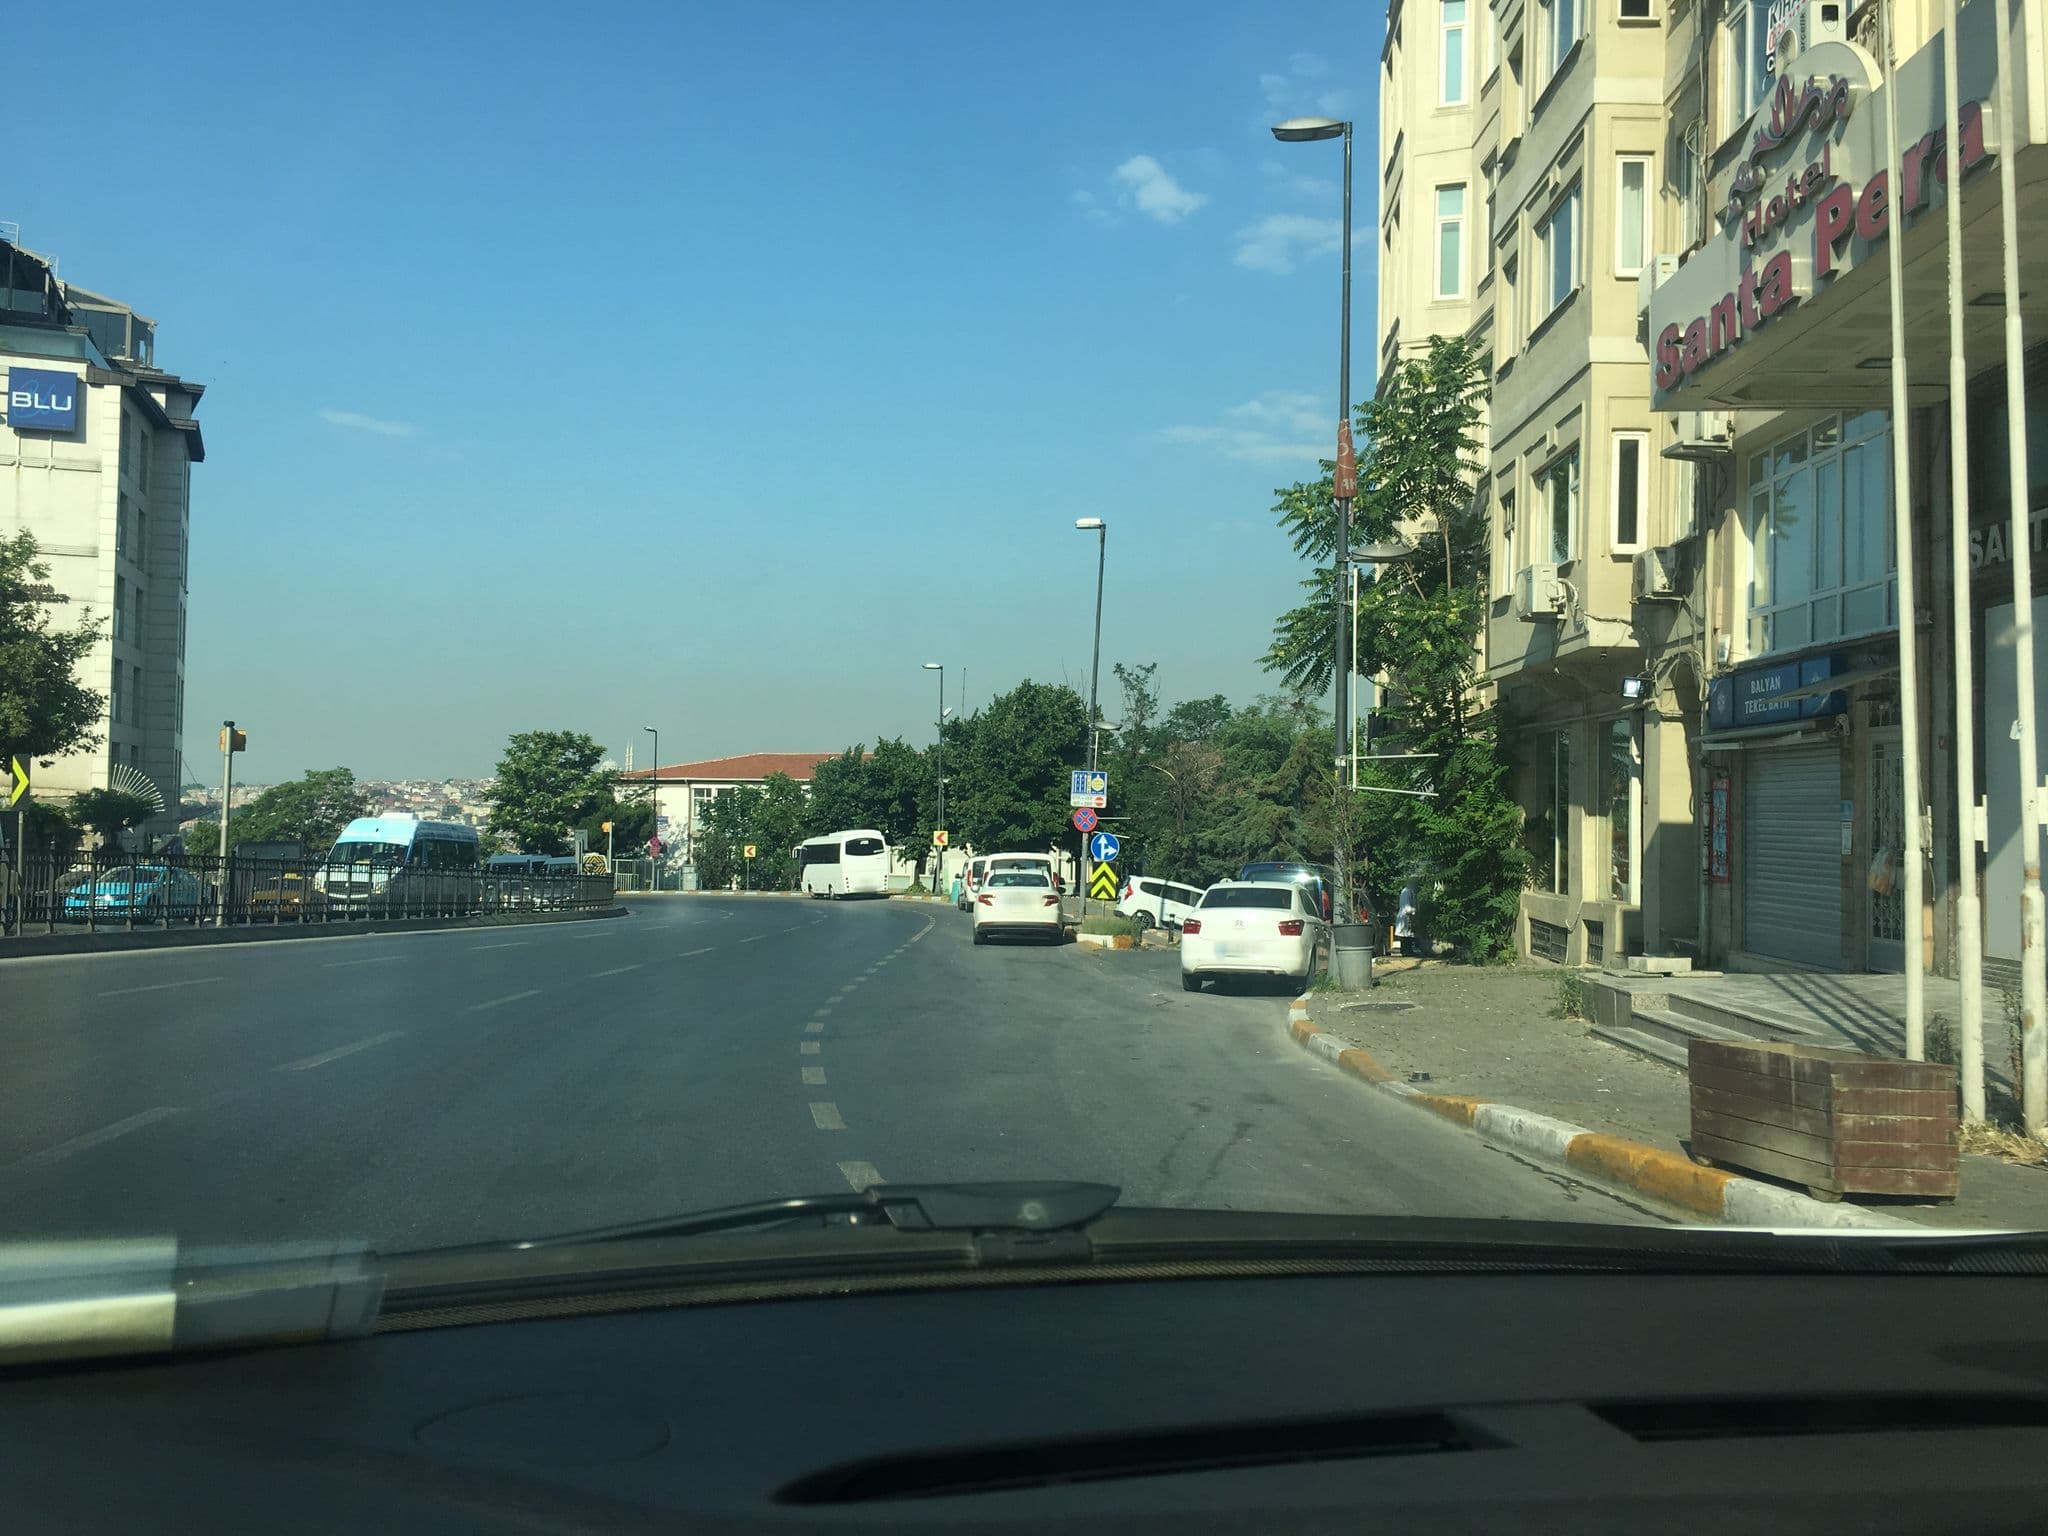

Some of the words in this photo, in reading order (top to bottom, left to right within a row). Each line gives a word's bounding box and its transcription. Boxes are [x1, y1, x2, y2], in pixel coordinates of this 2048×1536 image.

[1742, 139, 1831, 246] Hotel
[1656, 250, 1795, 390] Santa
[1815, 100, 1985, 279] Pera
[12, 391, 72, 411] BLU
[1969, 507, 2048, 569] SAT
[1750, 676, 1781, 694] BALYAN
